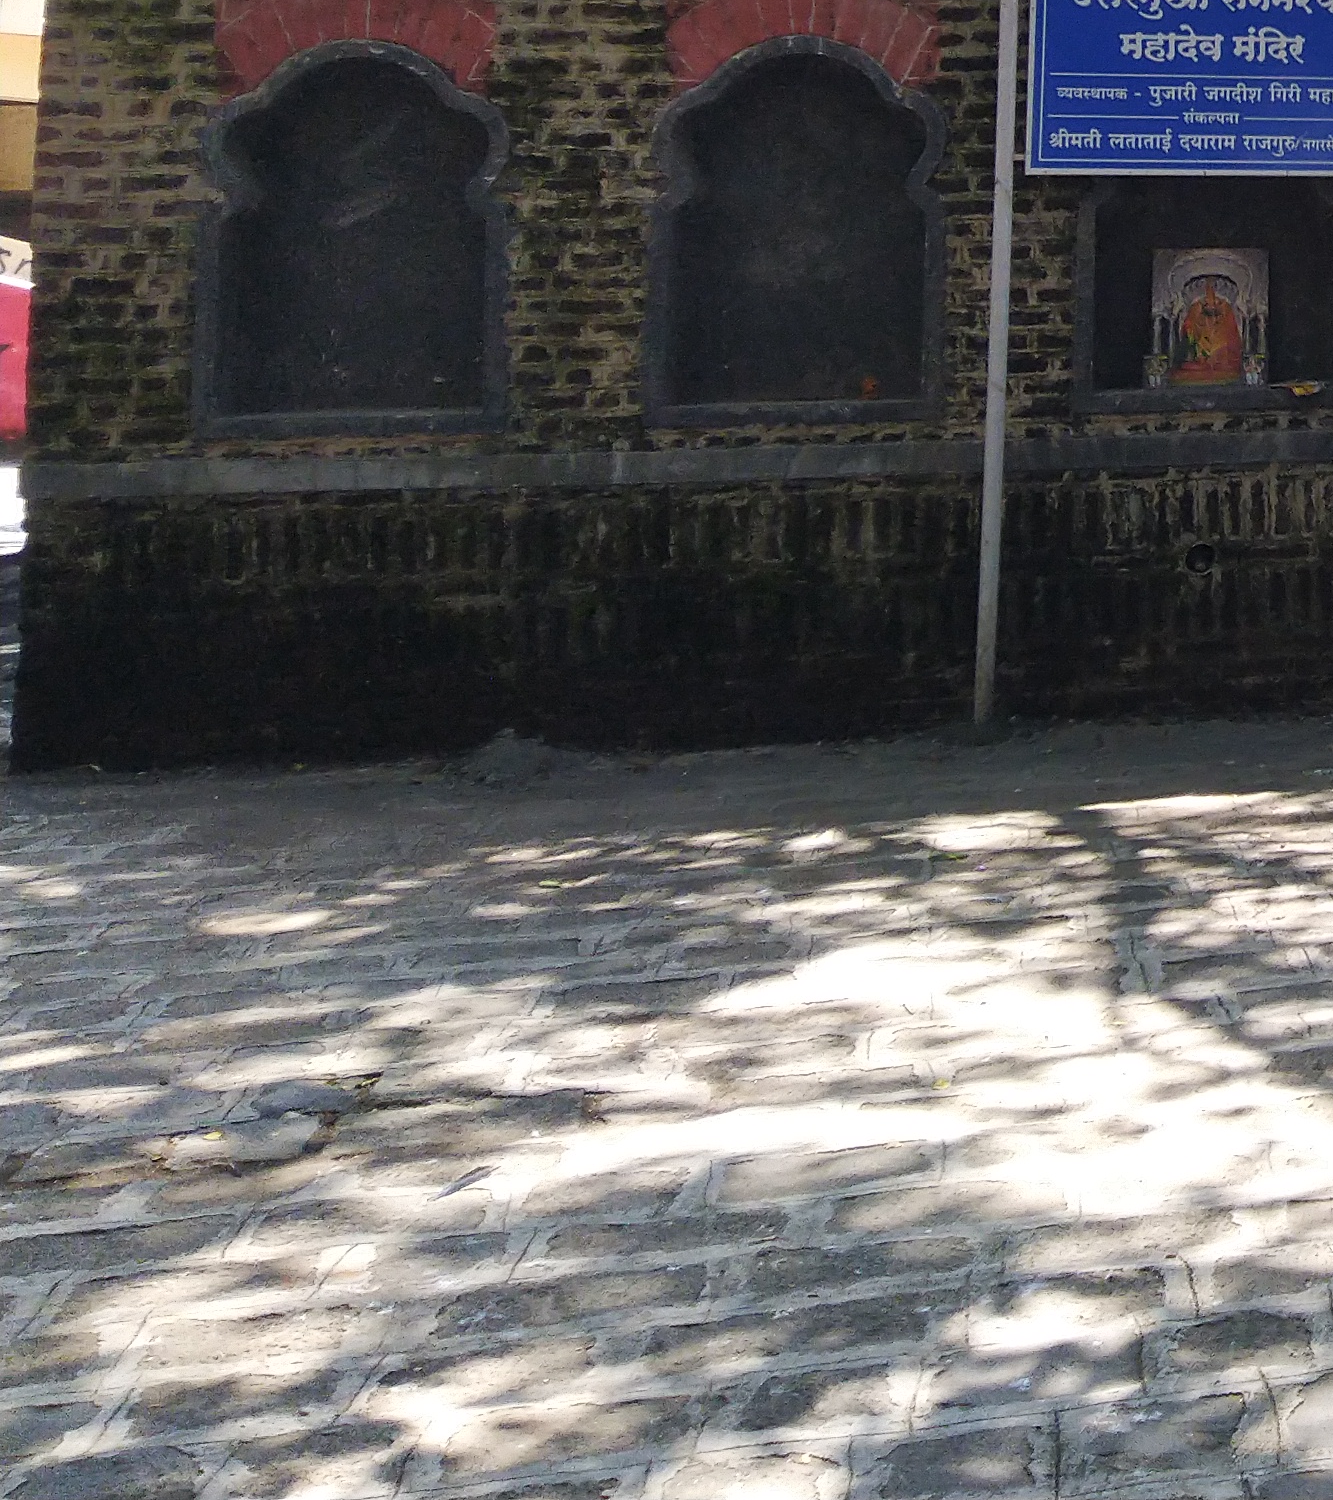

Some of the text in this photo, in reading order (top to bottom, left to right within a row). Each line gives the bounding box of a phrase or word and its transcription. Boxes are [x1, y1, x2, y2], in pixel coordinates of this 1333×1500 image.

[1119, 23, 1306, 64] महादेव मंदिर
[1056, 86, 1129, 100] व्यवस्थापक
[1148, 81, 1197, 107] पुजारी
[1203, 82, 1263, 103] जगदीश
[1268, 82, 1302, 103] गिरी
[1182, 107, 1239, 124] संकल्पना
[1049, 128, 1102, 149] श्रीमती
[1108, 128, 1173, 153] लताताई
[1178, 133, 1237, 151] दयाराम
